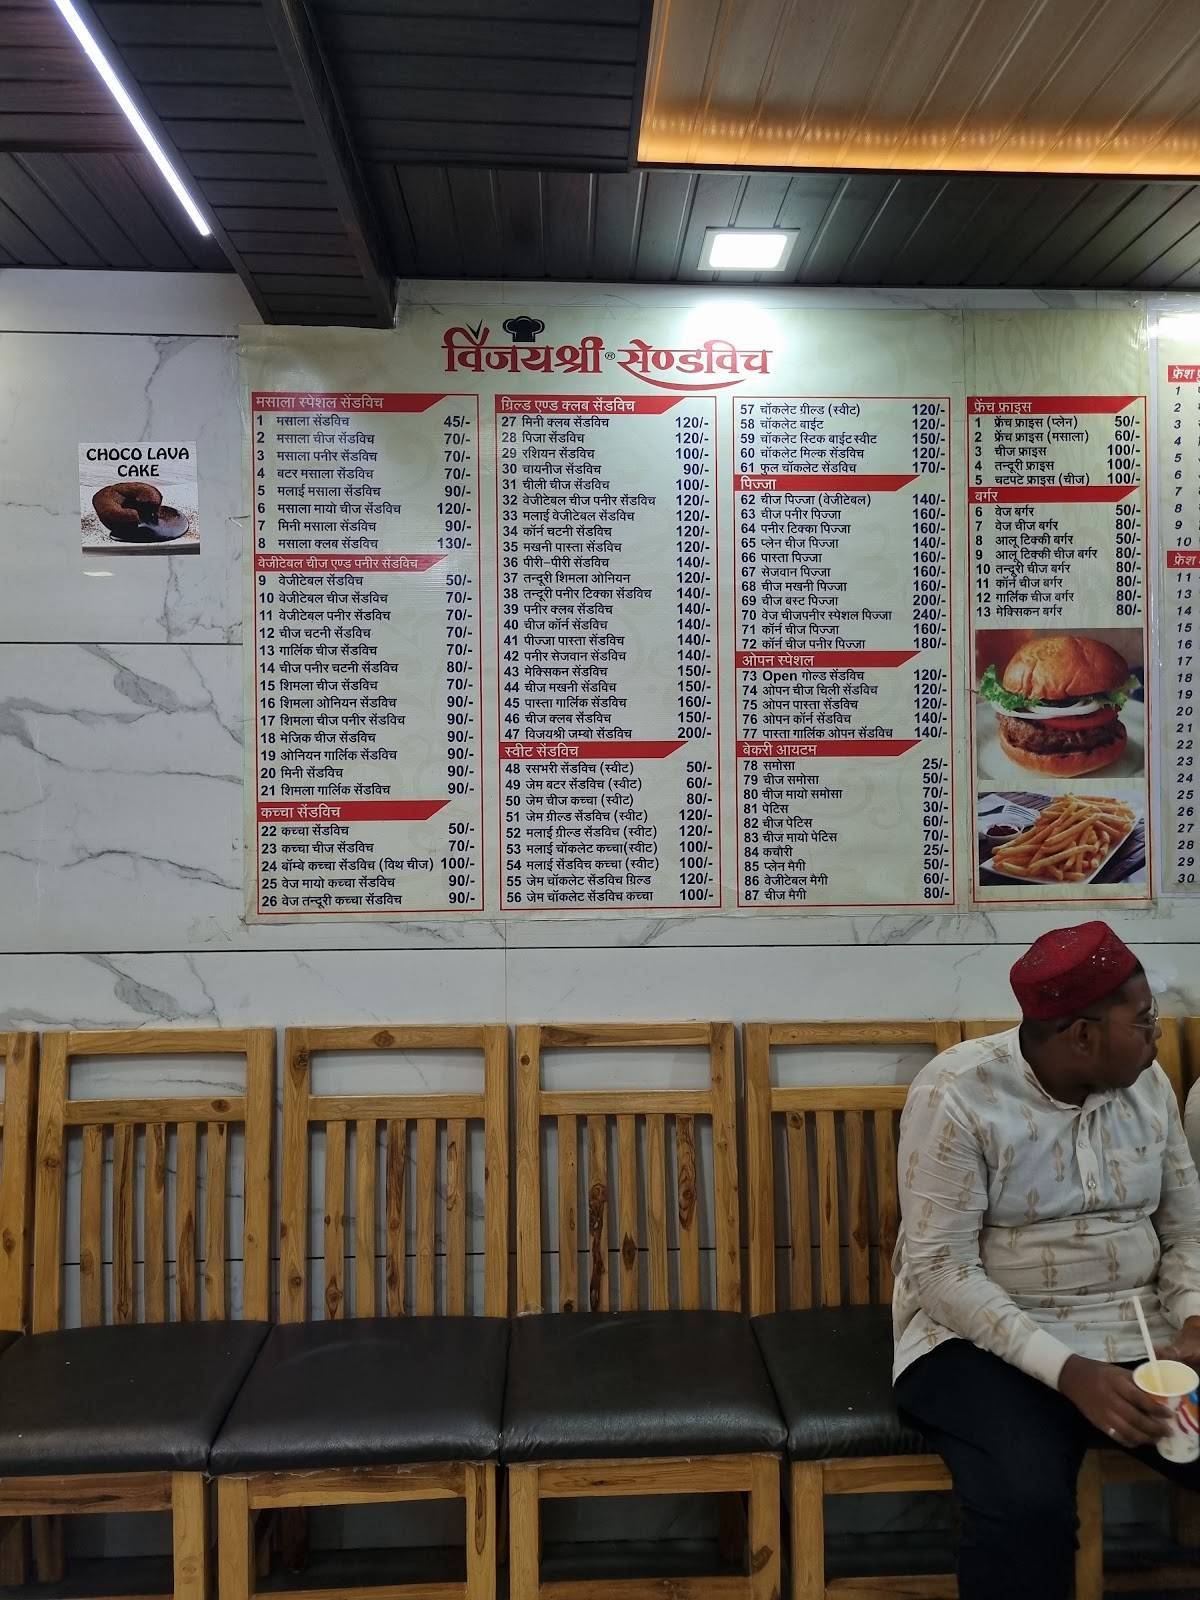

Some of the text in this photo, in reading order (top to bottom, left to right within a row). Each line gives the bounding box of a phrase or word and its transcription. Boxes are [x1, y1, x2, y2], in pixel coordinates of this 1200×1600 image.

[1175, 386, 1181, 395] 1
[256, 395, 384, 409] मसाला स्पेशल सेंडविच
[534, 400, 559, 413] एण्ड
[562, 400, 590, 411] क्लब
[592, 398, 636, 412] सेंडविच
[974, 399, 1032, 414] फ्रेंच फ्राइस
[256, 413, 470, 428] 1 मसाला सेंडविच 45/-
[740, 419, 755, 429] 58
[799, 417, 824, 431] बाईट
[912, 417, 946, 431] 120/-
[974, 417, 980, 428] 1
[994, 415, 1013, 428] फ्रेंच
[1014, 418, 1044, 429] फ्राइस
[1114, 416, 1140, 427] 50/-
[86, 447, 189, 461] CHOCO LAVA
[501, 445, 709, 460] 29 रशियन सेंडविच 100/-
[975, 444, 1140, 458] 3 चीज फ्राइस 100/-
[1174, 453, 1182, 463] 5
[117, 464, 160, 477] CAKE
[502, 478, 516, 490] 31
[549, 477, 572, 490] चीज
[574, 477, 610, 490] सेंडविच
[676, 479, 709, 491] 100/-
[740, 476, 777, 490] पिज्जा
[975, 488, 998, 502] बर्गर
[975, 504, 1141, 517] 6 वेज बर्गर 50/-
[741, 521, 946, 534] 64 पनीर टिक्का पिज्जा 160/-
[258, 536, 472, 549] 8 मसाला क्लब सेंडविच 130/-
[503, 539, 710, 553] 35 मखनी पास्ता सेंडविच 120/-
[975, 532, 1141, 548] 8 आलू टिक्की बर्गर 50/-
[1175, 537, 1192, 547] 10
[258, 556, 419, 570] वेजीटेबल चीज एण्ड पनीर सेंडविच
[741, 564, 946, 577] 67 सेजवान पिज्जा 160/-
[258, 573, 472, 586] 9 वेजीटेबल सेंडविच 50/-
[976, 592, 991, 603] 12
[1030, 589, 1052, 602] चीज
[1054, 589, 1074, 602] बर्गर
[1116, 589, 1142, 601] 80/-
[259, 625, 472, 639] 12 चीज चटनी सेंडविच 70/-
[742, 652, 815, 666] ओपन स्पेशल
[742, 668, 947, 684] 73 Open गोल्ड सेंडविच 120/-
[504, 679, 711, 693] 44 चीज मखनी सेंडविच 150/-
[260, 695, 474, 709] 16 शिमला ओनियन सेंडविच 90/-
[1175, 707, 1193, 717] 20
[504, 726, 712, 740] 47 विजयश्री जम्बो सेंडविच 200/-
[504, 744, 579, 757] स्वीट सेंडविच
[742, 742, 817, 756] बेकरी आयटम
[743, 758, 948, 771] 78 समोसा 25/-
[260, 765, 474, 779] 20 मिनी सेंडविच 90/-
[260, 805, 341, 818] कच्चा सेंडविच
[506, 811, 519, 822] 51
[526, 809, 544, 822] जेम
[574, 808, 611, 821] सेंडविच
[679, 809, 712, 821] 120/-
[261, 822, 474, 837] 22 कच्चा सेंडविच 50/-
[744, 846, 759, 857] 84
[923, 843, 949, 856] 25/-
[1177, 873, 1195, 884] 30
[744, 886, 950, 901] 87 चीज मैगी 80/-
